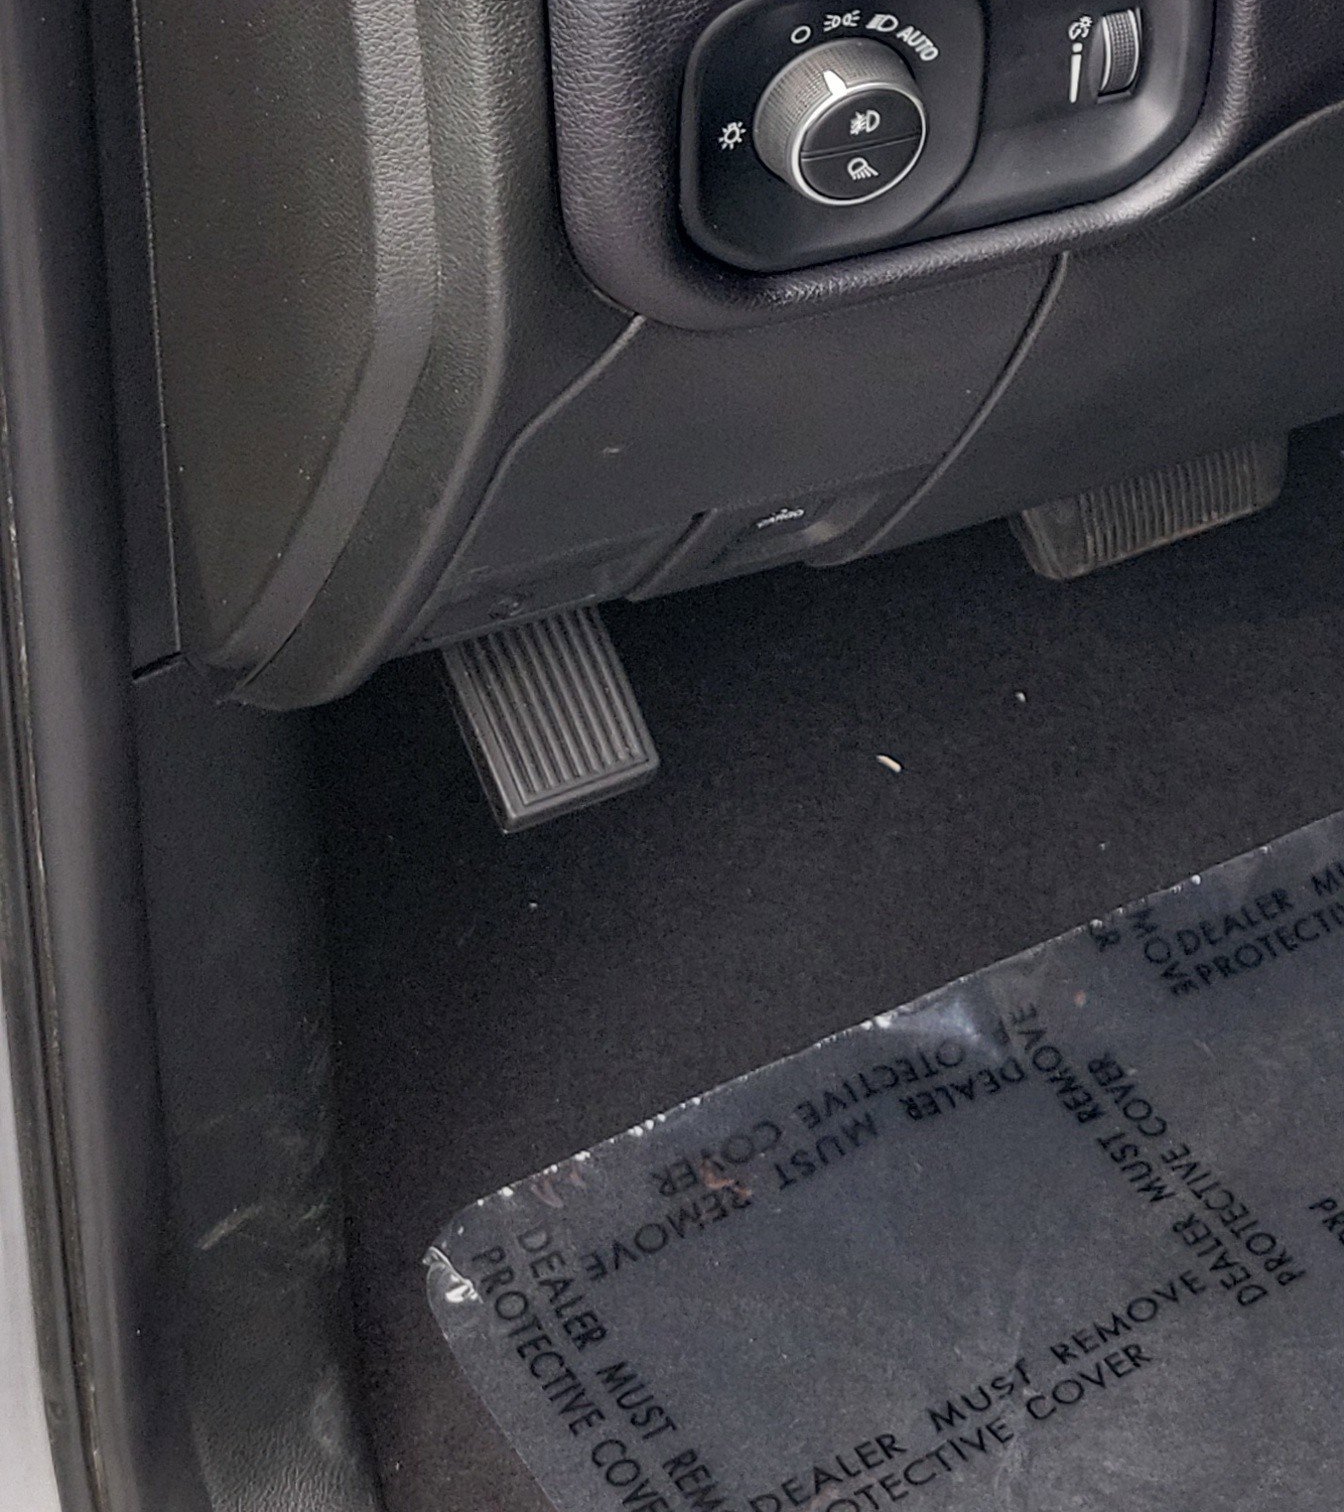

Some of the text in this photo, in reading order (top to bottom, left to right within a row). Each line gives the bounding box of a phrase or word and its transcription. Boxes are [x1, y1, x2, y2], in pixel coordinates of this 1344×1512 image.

[896, 26, 939, 61] AUTO
[1176, 888, 1294, 957] DEALER
[583, 1056, 1025, 1282] DEALER MUST REMOVE
[650, 1119, 784, 1197] COVER
[1010, 1003, 1268, 1306] DEALER MUST REMOVE
[1088, 1052, 1306, 1287] PROTECTIVE COVER
[471, 1245, 671, 1512] PROTECTIVE COVE
[517, 1225, 607, 1351] DEALER
[596, 1361, 678, 1440] MUST
[749, 1269, 1208, 1512] DEALER MUST REMOVE
[825, 1343, 1153, 1512] OTECTIVE COVER
